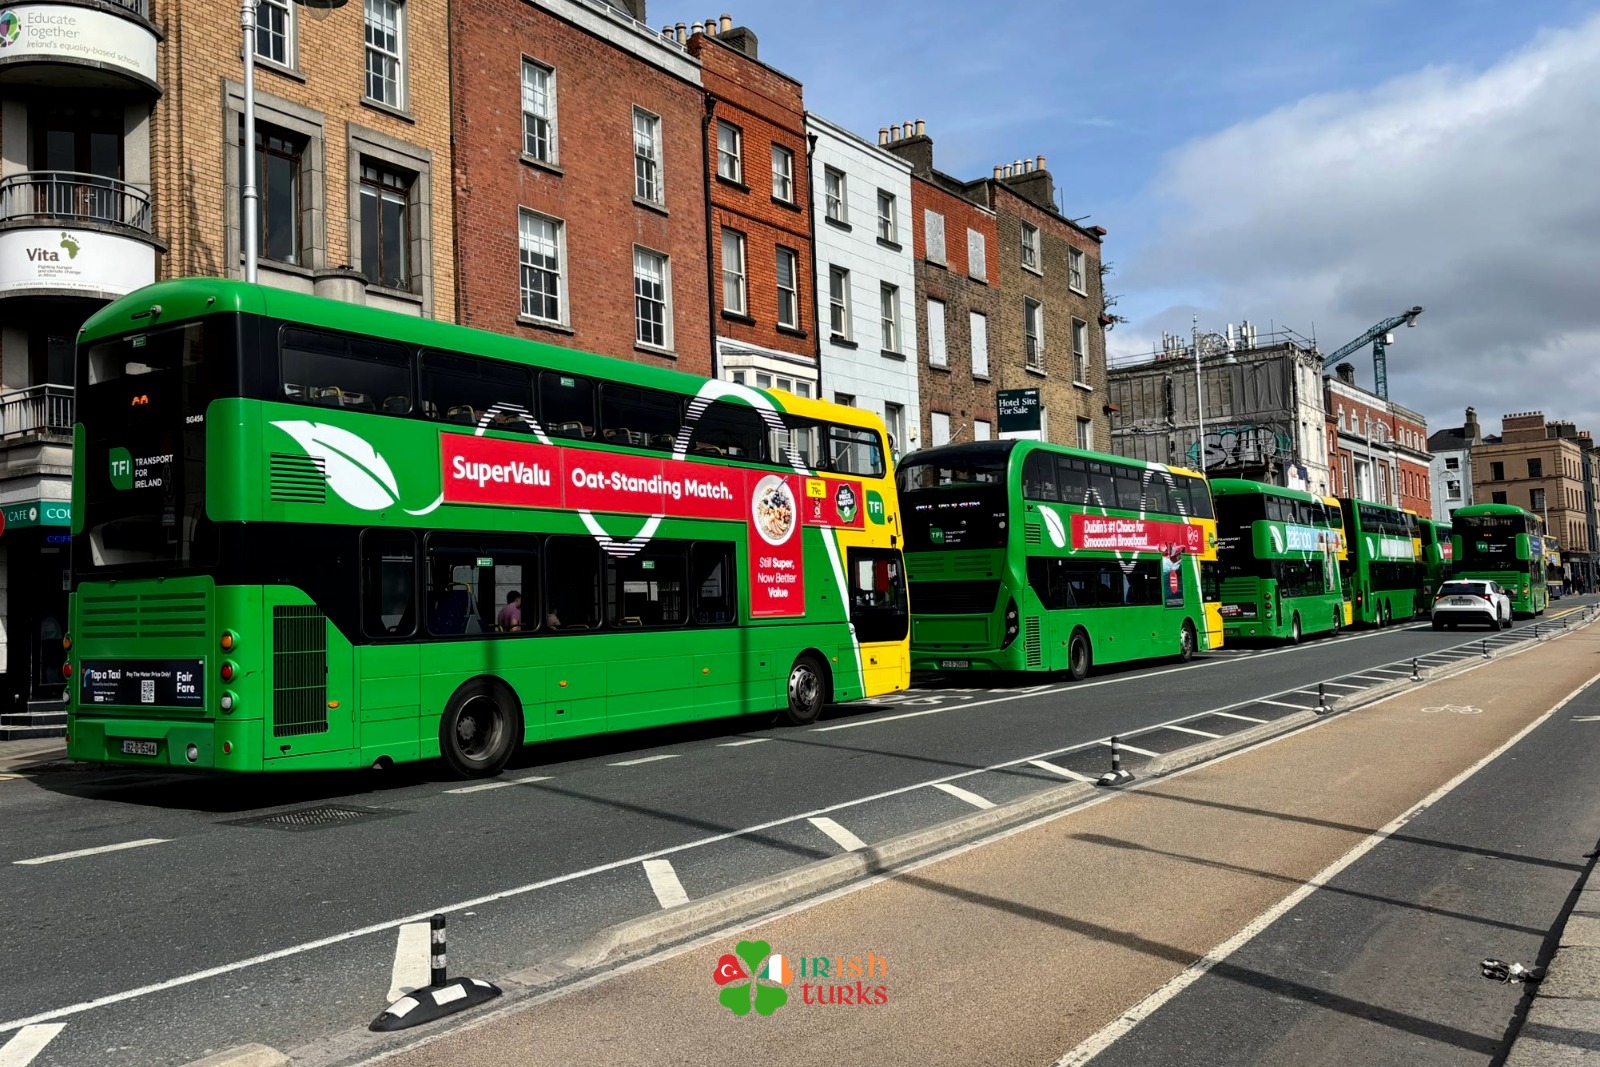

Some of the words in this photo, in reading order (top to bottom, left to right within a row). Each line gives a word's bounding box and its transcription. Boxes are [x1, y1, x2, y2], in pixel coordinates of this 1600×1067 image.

[27, 12, 77, 26] Educate
[25, 25, 80, 39] Together
[26, 40, 57, 49] Ireland's
[59, 43, 116, 59] equality-based
[117, 54, 140, 68] schools
[26, 248, 60, 262] Vita
[998, 398, 1020, 407] Hotel
[1022, 397, 1037, 406] Site
[999, 407, 1012, 416] For
[1013, 406, 1028, 414] Sale
[134, 454, 174, 467] TRANSPORT
[111, 459, 130, 477] TFI
[134, 468, 148, 478] FOR
[134, 478, 162, 489] IRELAND
[452, 455, 551, 488] SuperValu
[571, 467, 681, 500] Oat-Standing
[684, 478, 733, 500] Match.
[868, 500, 883, 515] TFI
[8, 509, 28, 522] CAFE
[1084, 519, 1107, 533] Dublin's
[1116, 519, 1135, 533] Choice
[1136, 519, 1144, 532] for
[1117, 533, 1148, 546] Broadband
[759, 556, 772, 568] Still
[772, 557, 795, 570] Super,
[757, 572, 775, 583] Now
[775, 572, 797, 583] Better
[767, 586, 789, 598] Value
[90, 669, 102, 682] Tap
[107, 669, 121, 679] Taxi
[176, 671, 193, 682] Fair
[176, 682, 195, 693] Fare
